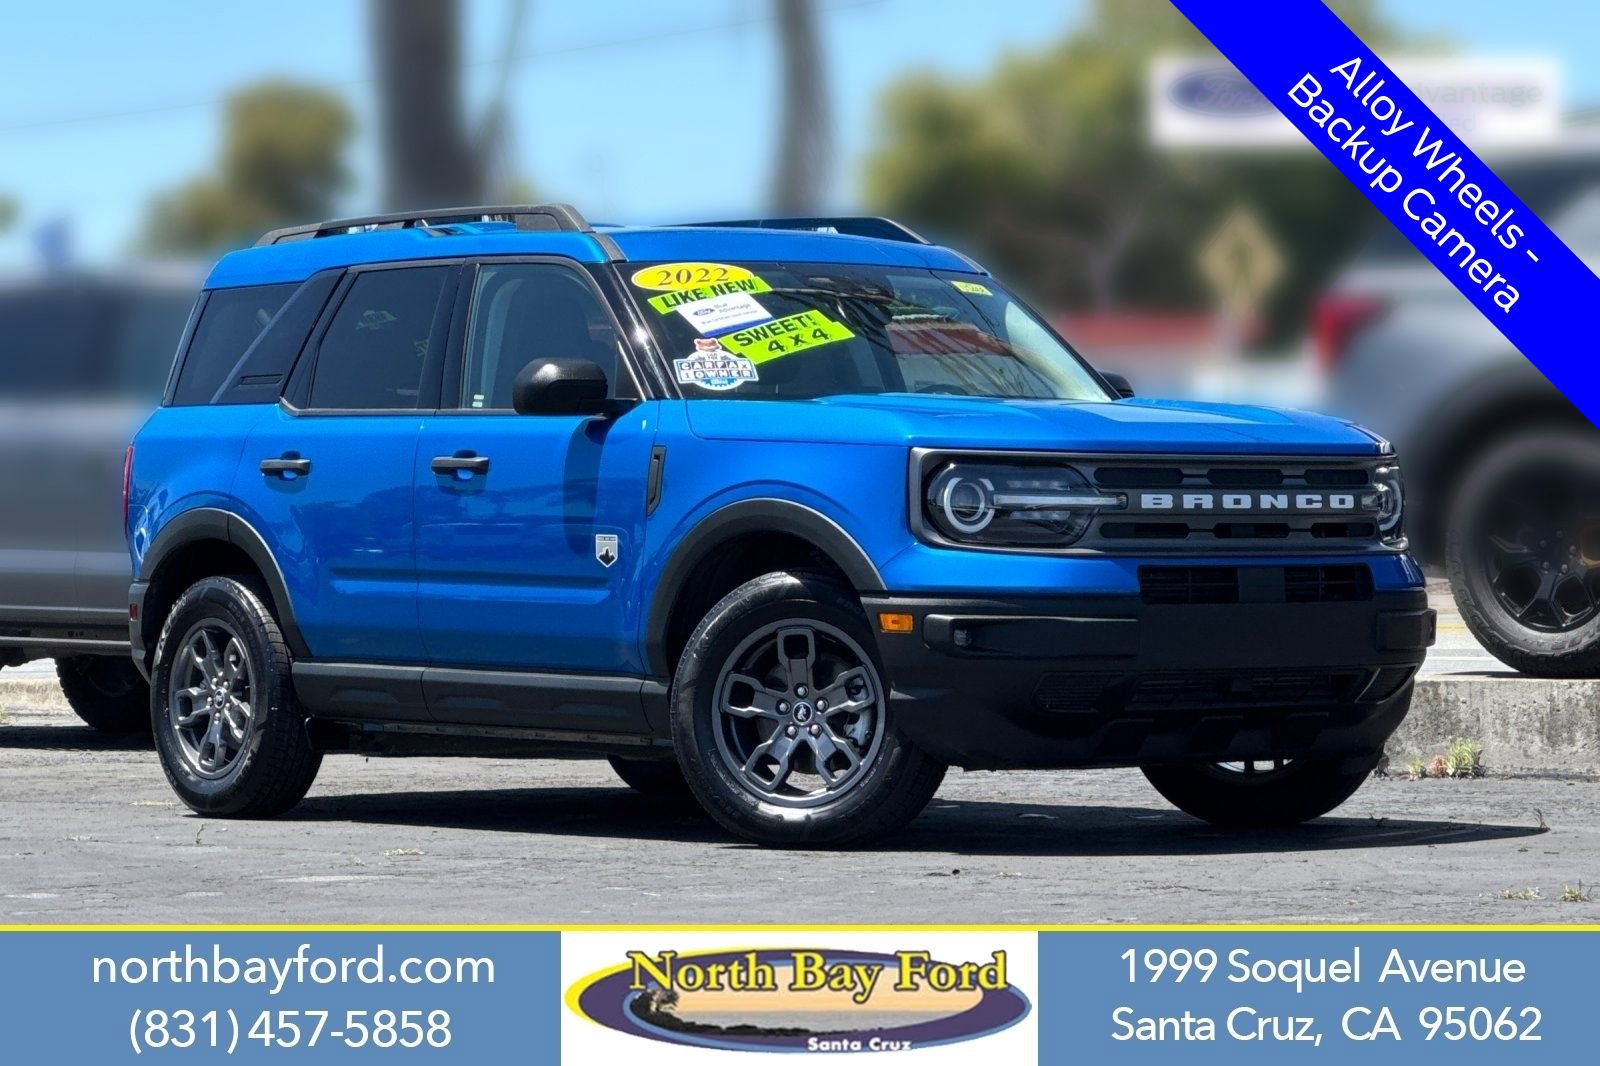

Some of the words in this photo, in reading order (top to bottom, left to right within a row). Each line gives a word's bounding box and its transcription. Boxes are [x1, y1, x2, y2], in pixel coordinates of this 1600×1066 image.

[657, 268, 729, 286] 2022
[661, 287, 706, 308] LIKE
[709, 279, 757, 297] NEW
[732, 314, 818, 347] SWEET!
[768, 340, 786, 352] 4
[812, 327, 830, 340] 4
[680, 361, 750, 371] CARFAX
[694, 370, 752, 379] OWNER
[1140, 493, 1356, 510] BRONCO
